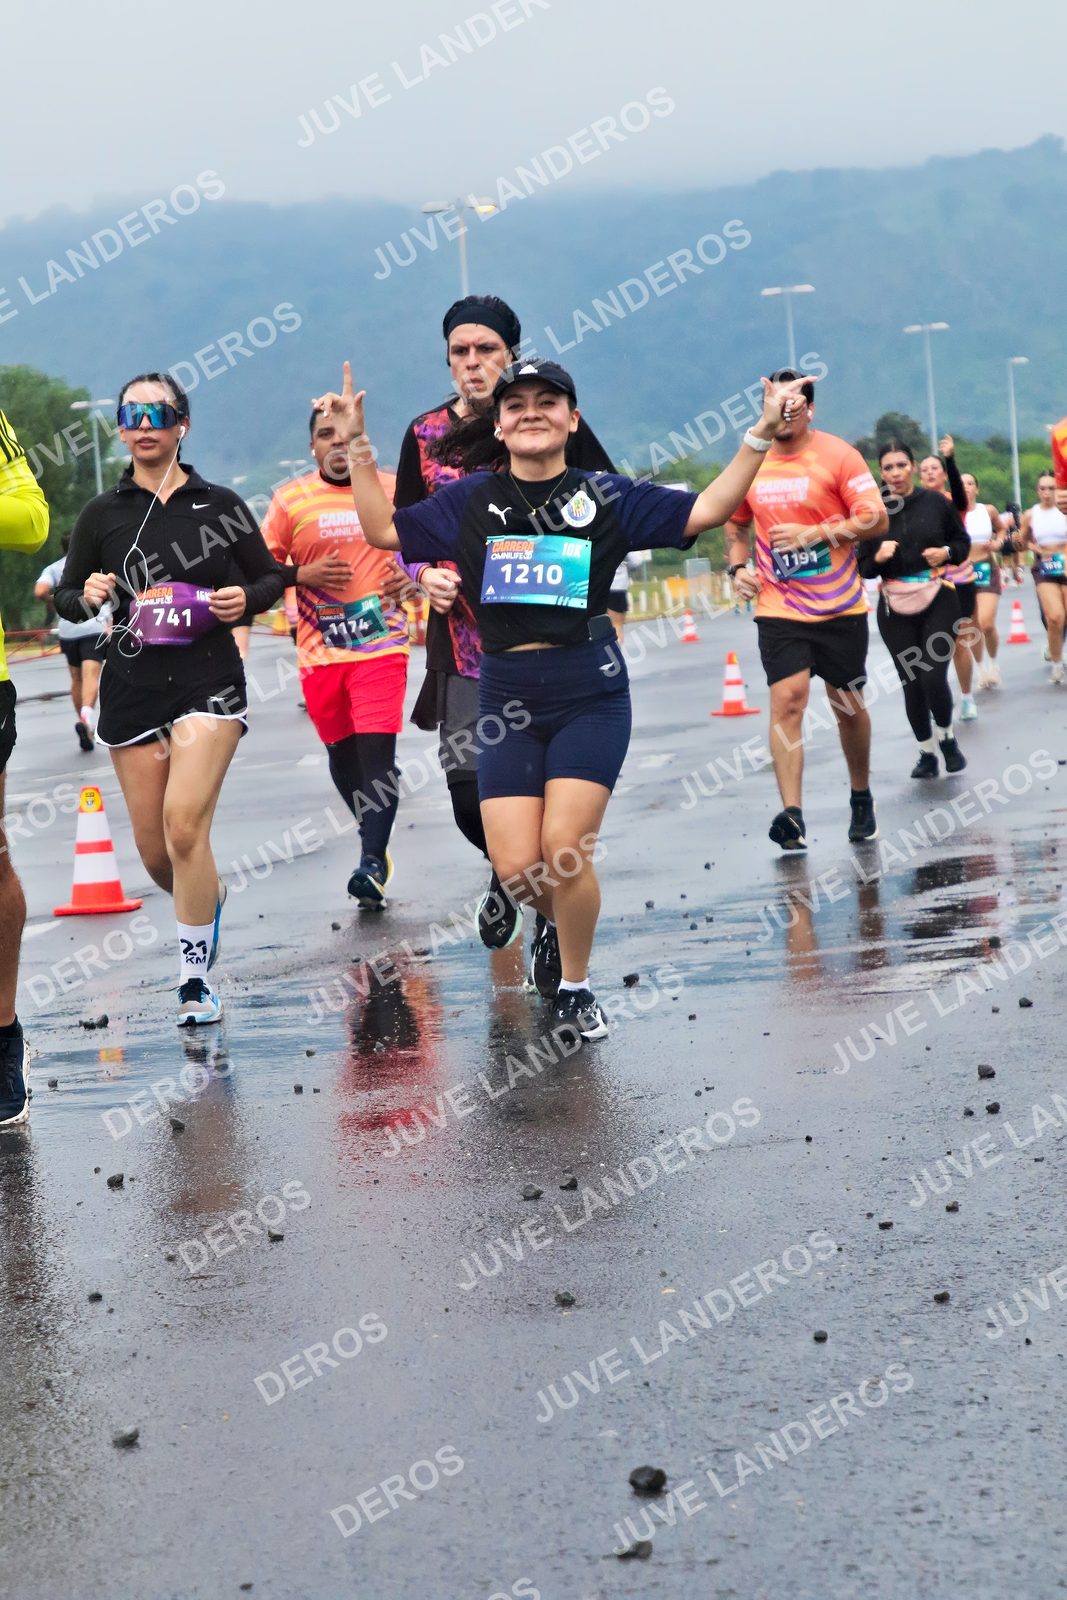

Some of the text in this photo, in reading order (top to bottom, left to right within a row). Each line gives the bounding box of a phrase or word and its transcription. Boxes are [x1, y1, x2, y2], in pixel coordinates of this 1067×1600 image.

[562, 542, 582, 558] 10K
[782, 551, 818, 567] 1191
[501, 563, 563, 585] 1210
[153, 608, 192, 627] 741
[329, 618, 370, 636] 1174
[180, 938, 207, 955] 21
[186, 955, 206, 964] KM
